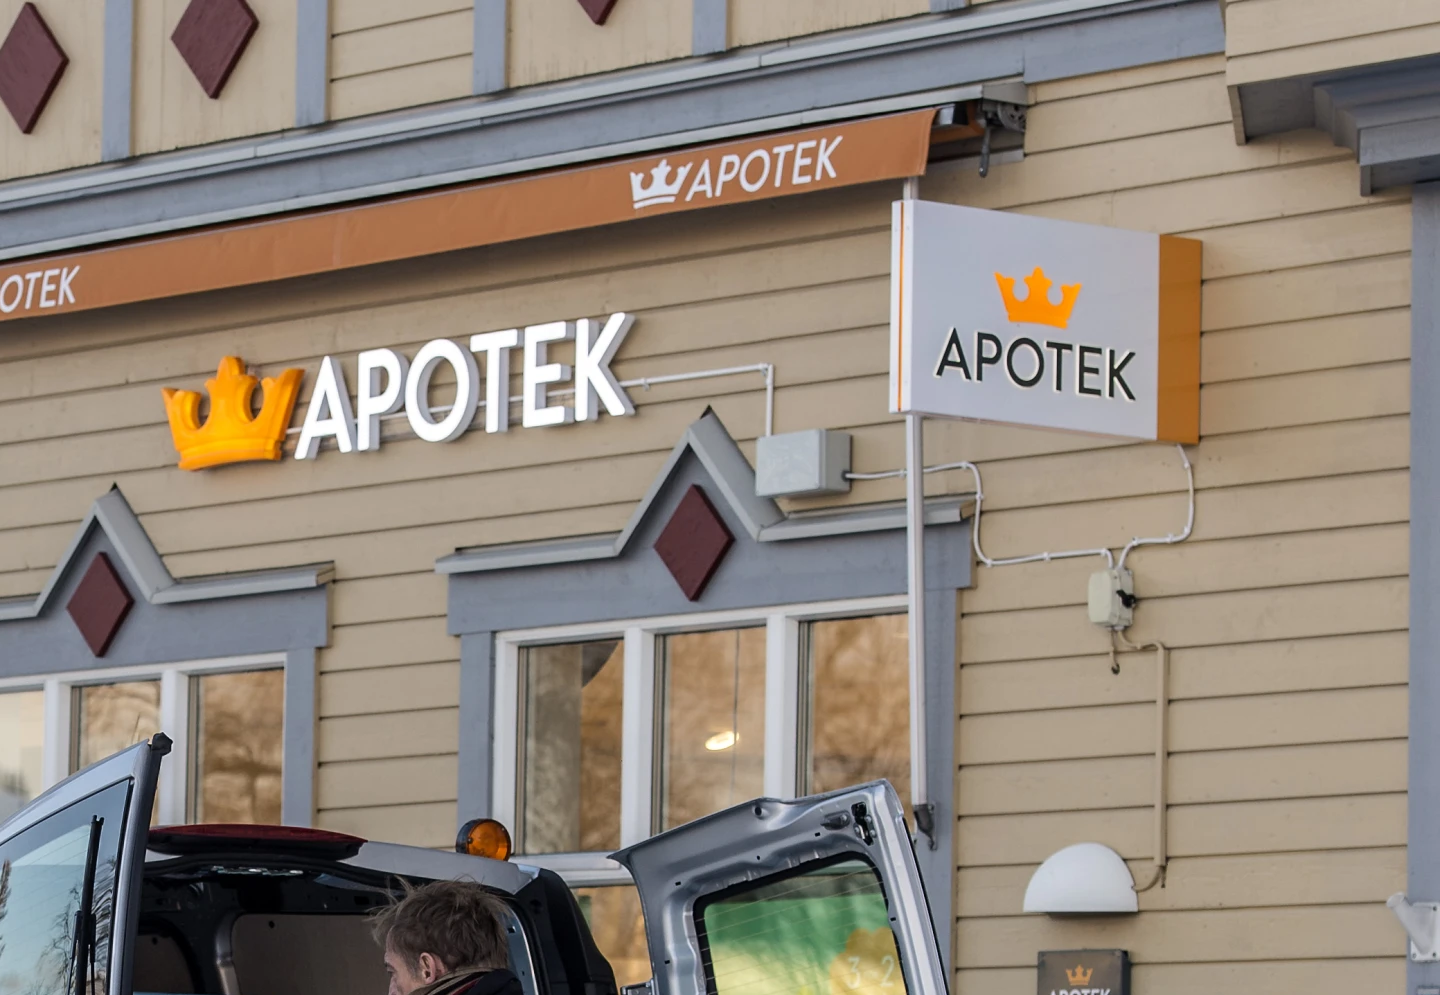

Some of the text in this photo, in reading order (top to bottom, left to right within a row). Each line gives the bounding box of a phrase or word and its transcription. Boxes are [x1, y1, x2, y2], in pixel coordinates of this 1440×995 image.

[685, 135, 843, 201] APOTEK
[294, 311, 635, 461] APOTEK
[934, 326, 1137, 402] APOTEK
[847, 955, 895, 989] 3 2
